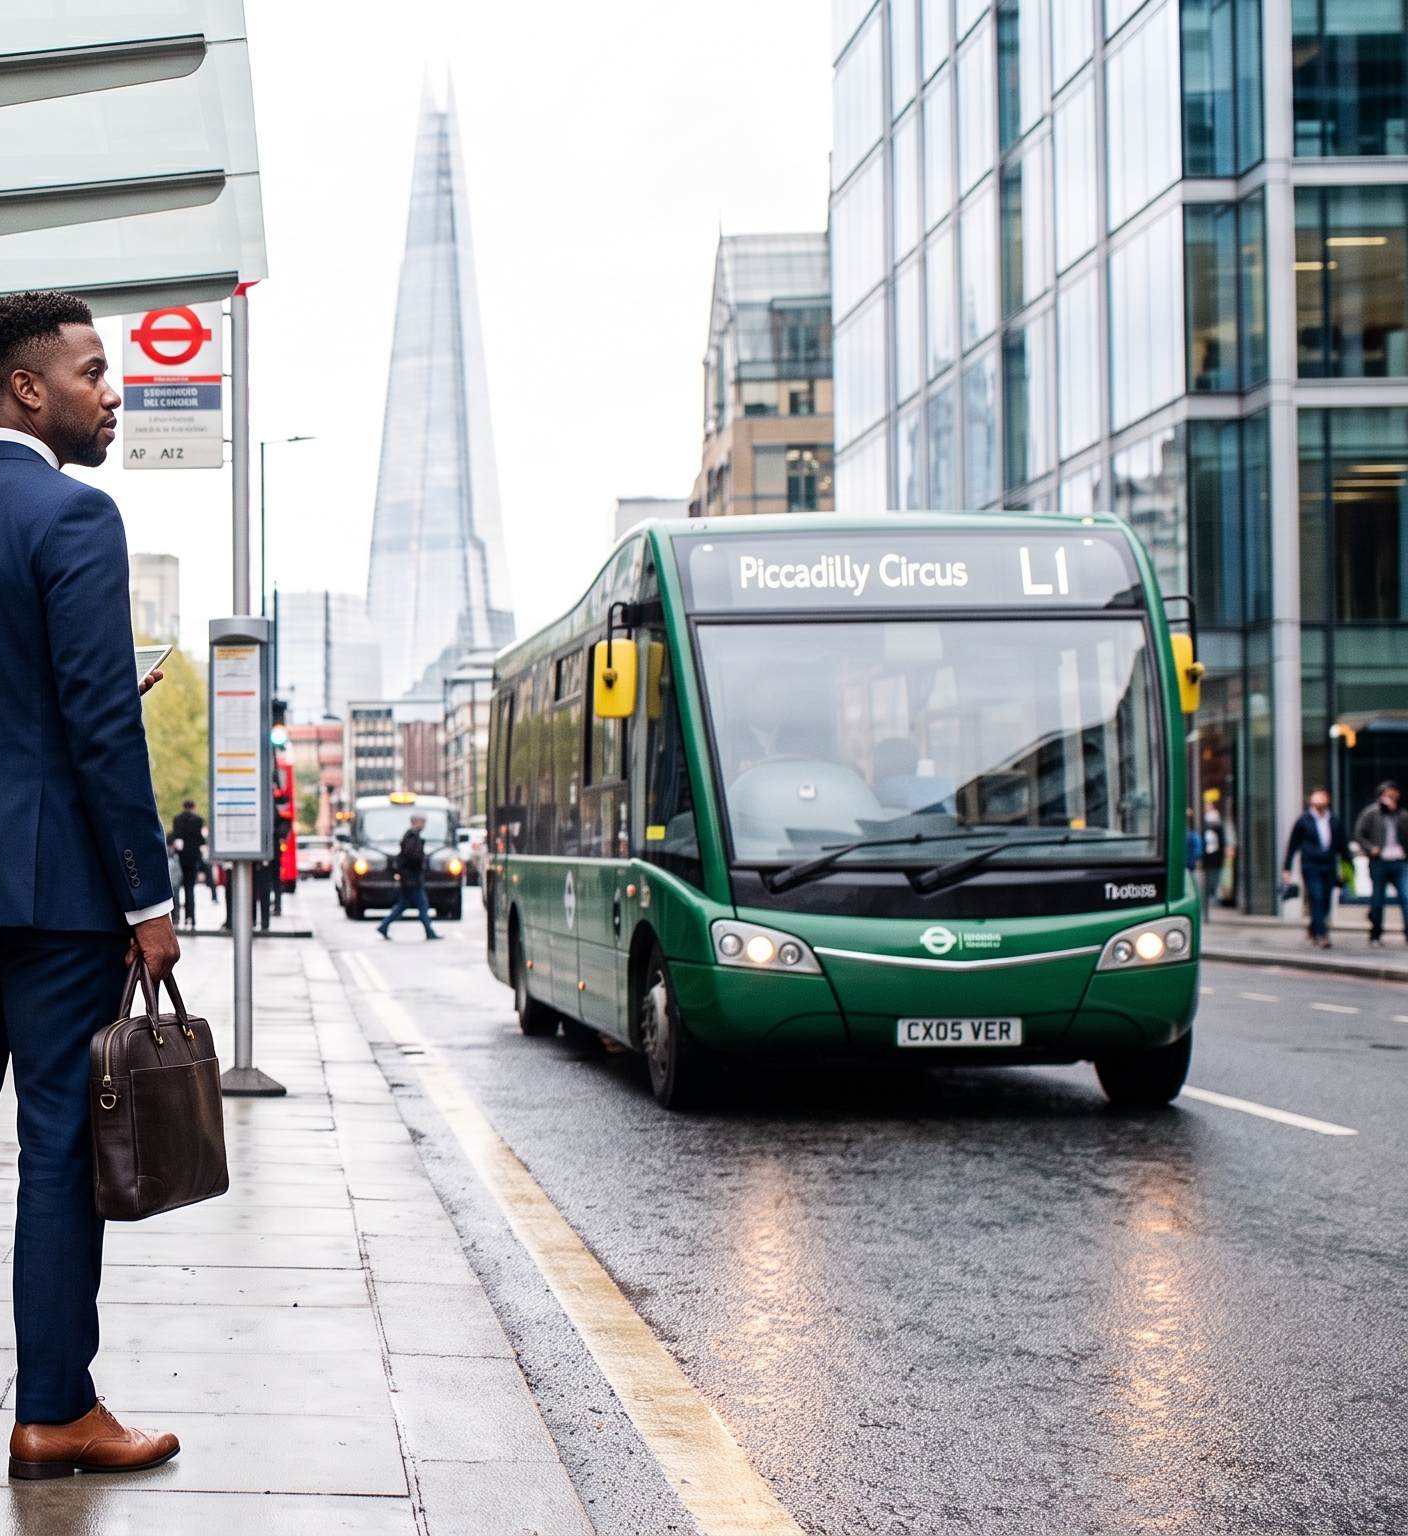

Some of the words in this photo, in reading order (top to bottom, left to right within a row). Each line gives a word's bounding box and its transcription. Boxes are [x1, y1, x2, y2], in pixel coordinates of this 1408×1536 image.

[740, 554, 870, 596] Piccadilly
[879, 554, 968, 587] Circus
[1019, 546, 1069, 595] L1
[971, 1021, 1011, 1041] VER
